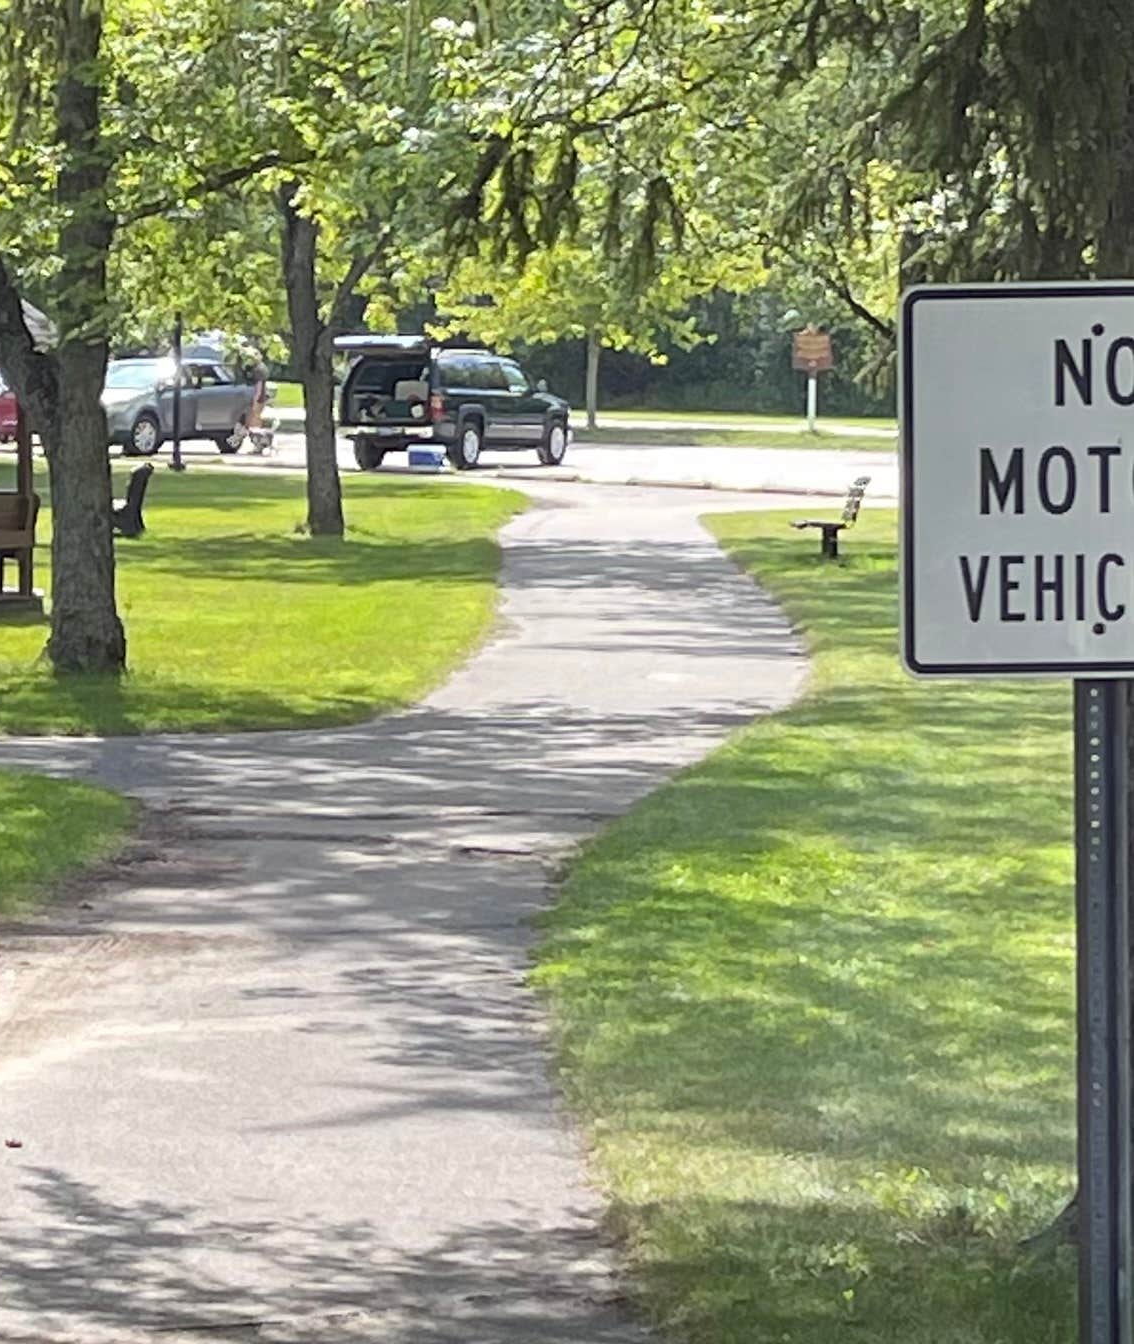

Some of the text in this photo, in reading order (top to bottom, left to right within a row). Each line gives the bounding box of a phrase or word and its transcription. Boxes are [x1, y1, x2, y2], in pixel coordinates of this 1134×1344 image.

[1054, 336, 1134, 406] NO
[979, 445, 1134, 515] MOT
[959, 552, 1126, 624] VEHIC
